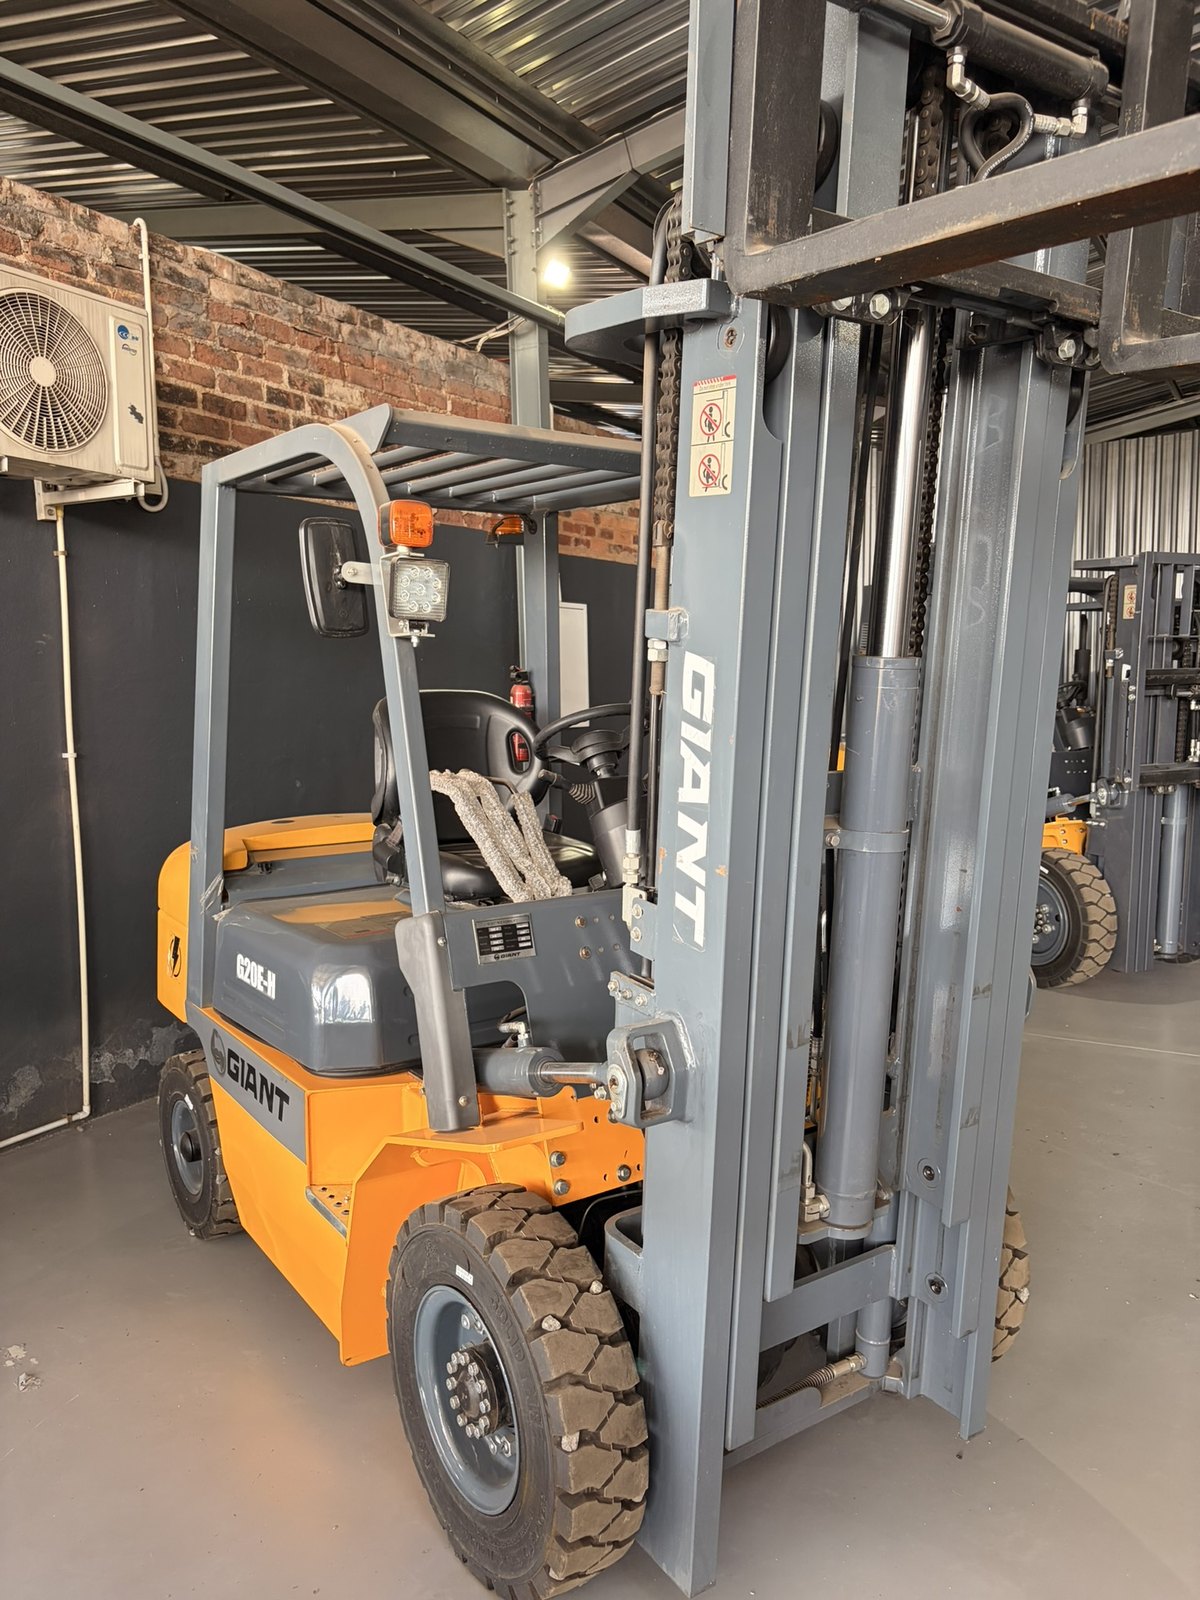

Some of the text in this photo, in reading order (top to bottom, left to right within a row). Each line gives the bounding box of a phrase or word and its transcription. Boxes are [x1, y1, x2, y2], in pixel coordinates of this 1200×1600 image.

[675, 650, 715, 947] GIANT
[236, 953, 276, 1000] G20E-H
[500, 951, 521, 959] GIANT
[227, 1048, 290, 1122] GIANT
